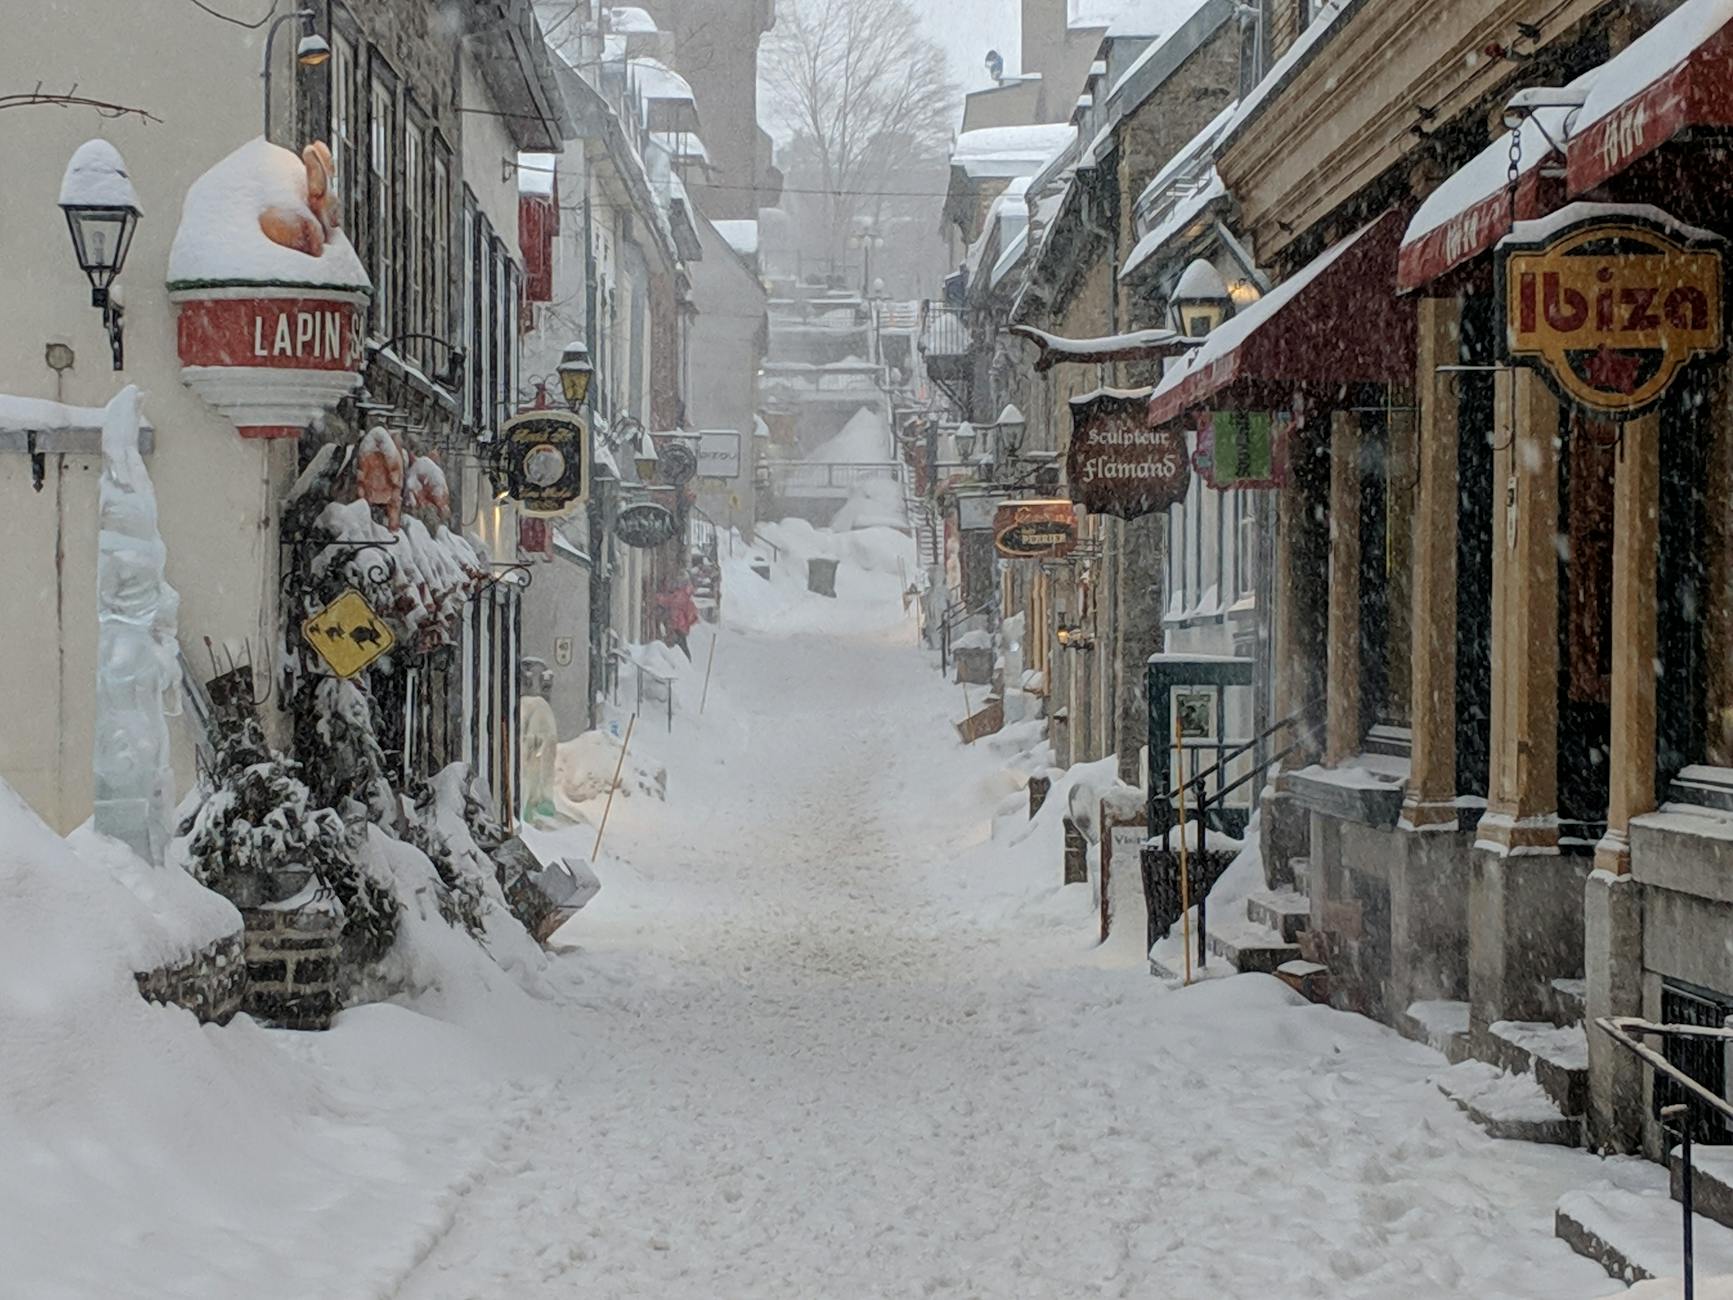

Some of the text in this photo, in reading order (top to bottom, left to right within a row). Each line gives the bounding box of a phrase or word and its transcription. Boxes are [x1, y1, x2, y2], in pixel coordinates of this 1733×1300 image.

[1519, 266, 1708, 333] Ibiza
[254, 311, 341, 359] LAPIN
[1087, 428, 1170, 448] Sculpteur
[1083, 453, 1177, 482] Flamand
